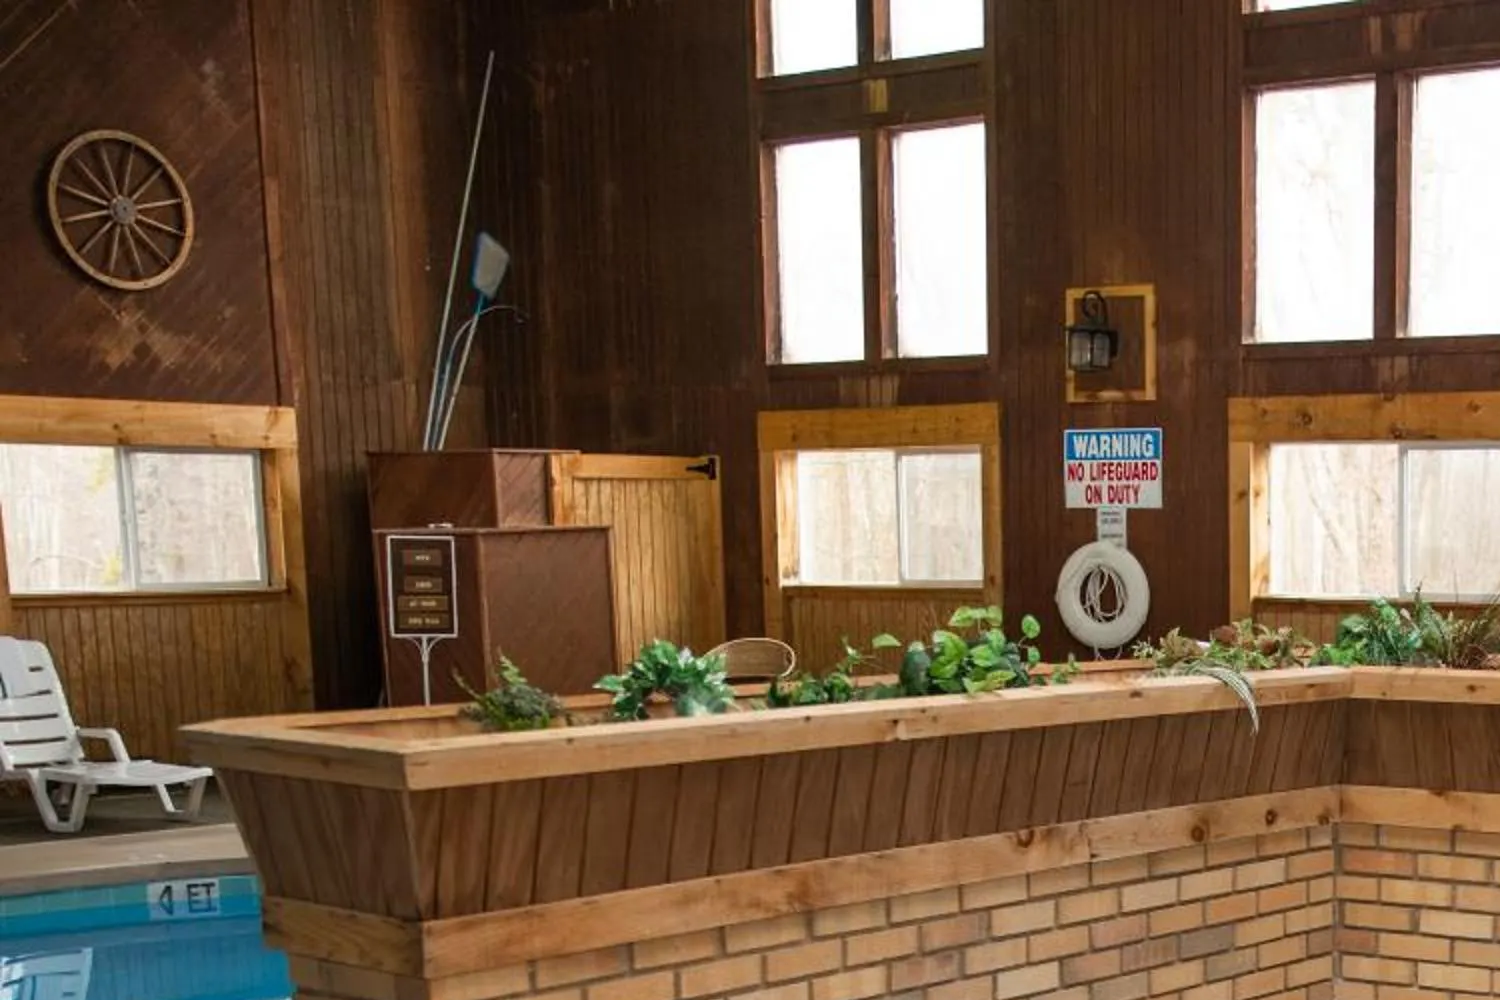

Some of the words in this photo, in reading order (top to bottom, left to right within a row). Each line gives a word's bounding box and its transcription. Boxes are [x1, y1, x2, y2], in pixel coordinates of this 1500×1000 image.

[1073, 434, 1154, 459] WARNING
[1067, 462, 1085, 482] NO
[1090, 461, 1159, 482] LIFEGUARD
[1085, 485, 1102, 504] ON
[1107, 484, 1141, 504] DUTY
